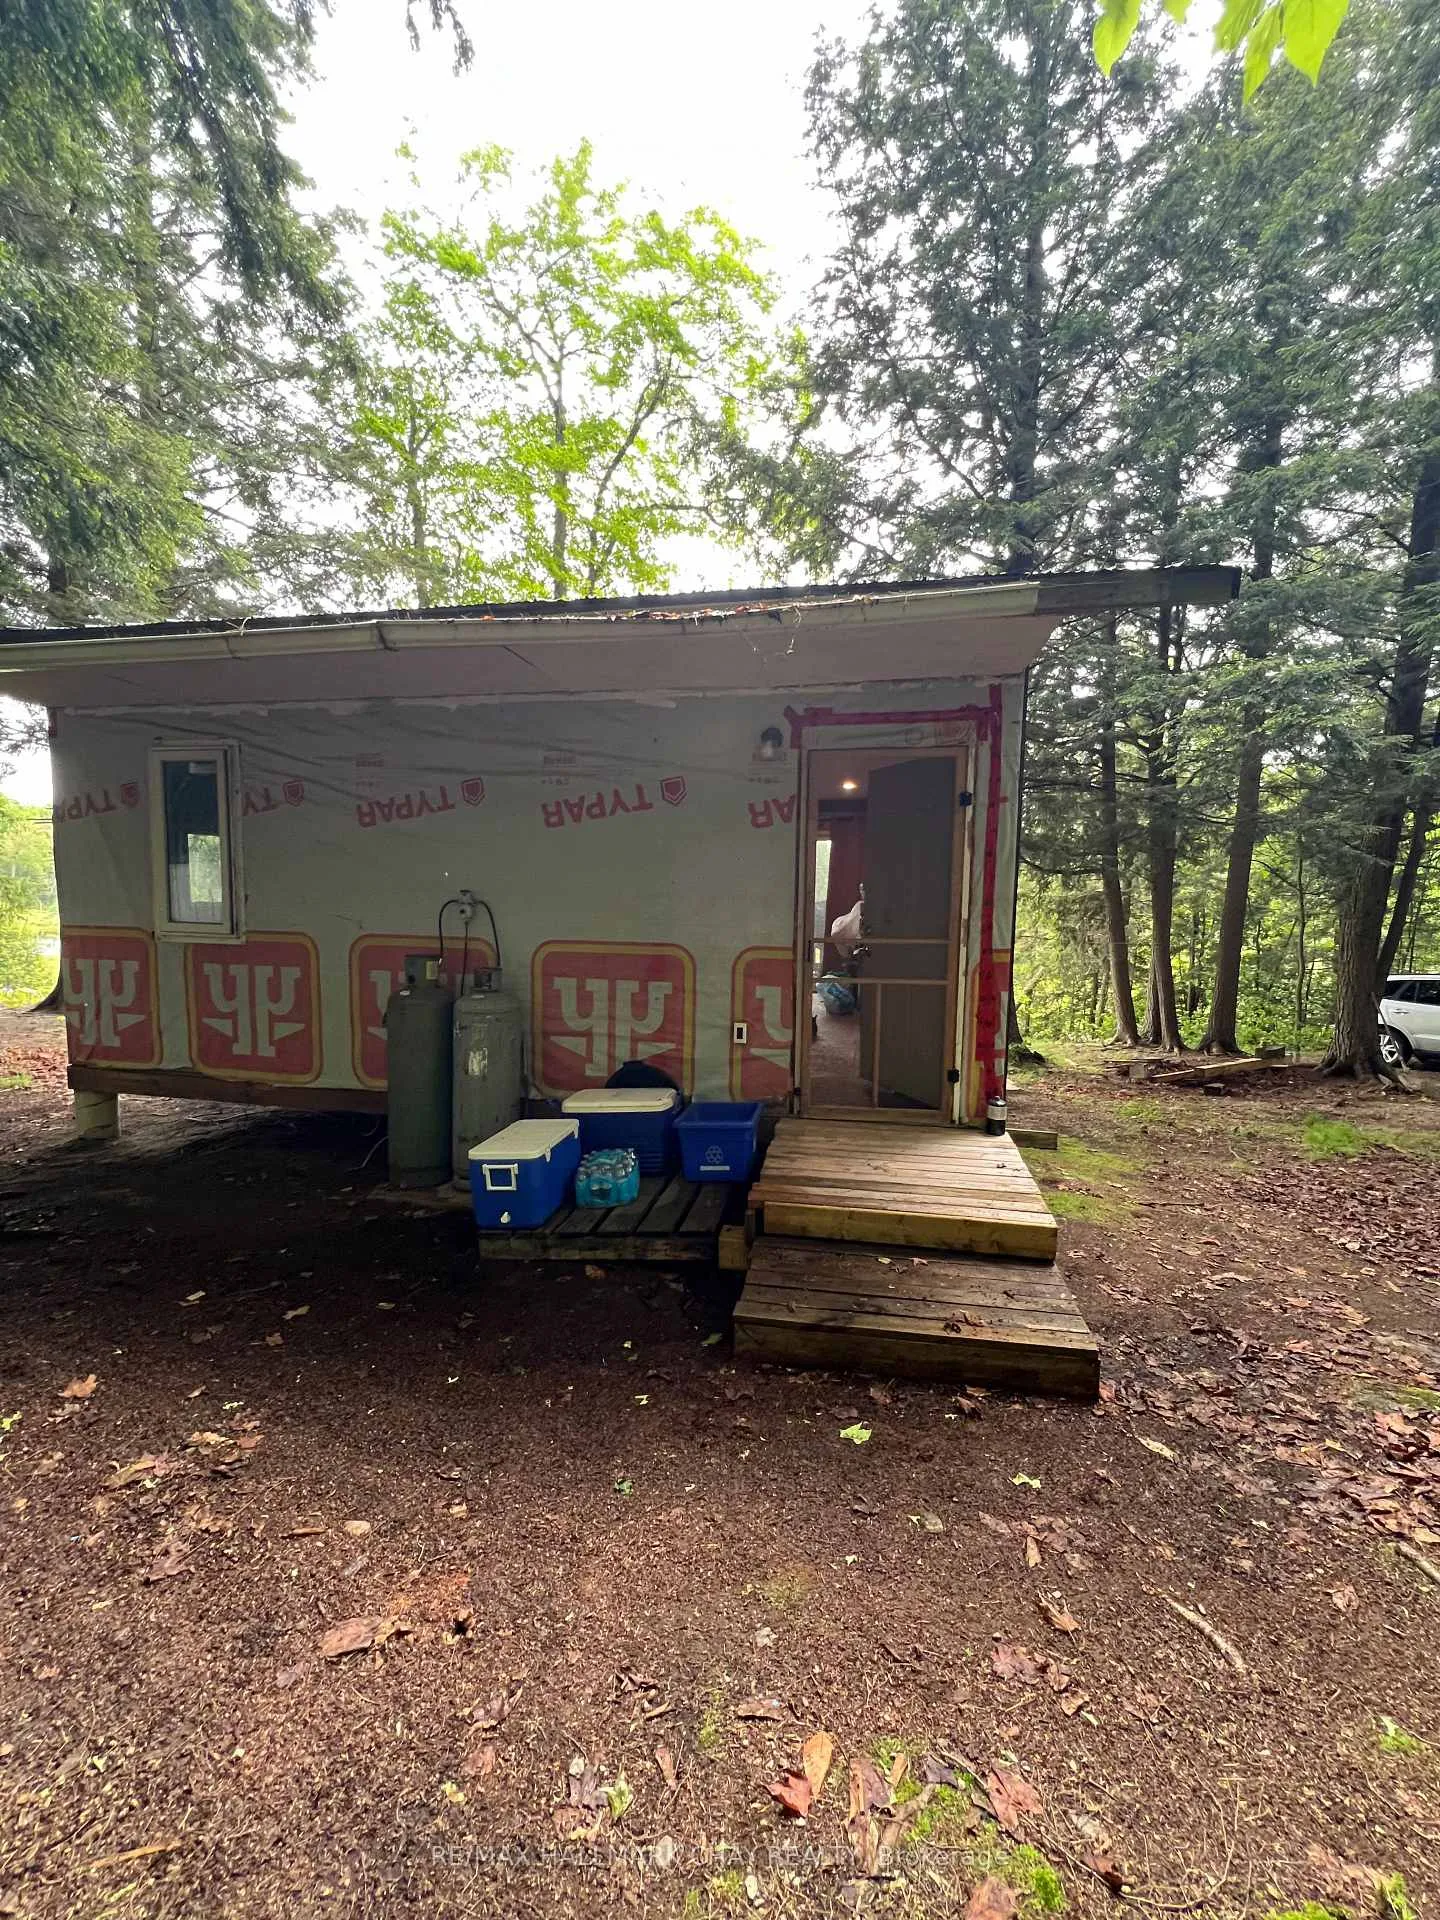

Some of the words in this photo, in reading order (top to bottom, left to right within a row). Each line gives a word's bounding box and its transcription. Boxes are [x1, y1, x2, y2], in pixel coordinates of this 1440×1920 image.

[355, 786, 456, 828] TYPAR
[541, 785, 655, 828] TYPAR
[747, 793, 797, 829] AR
